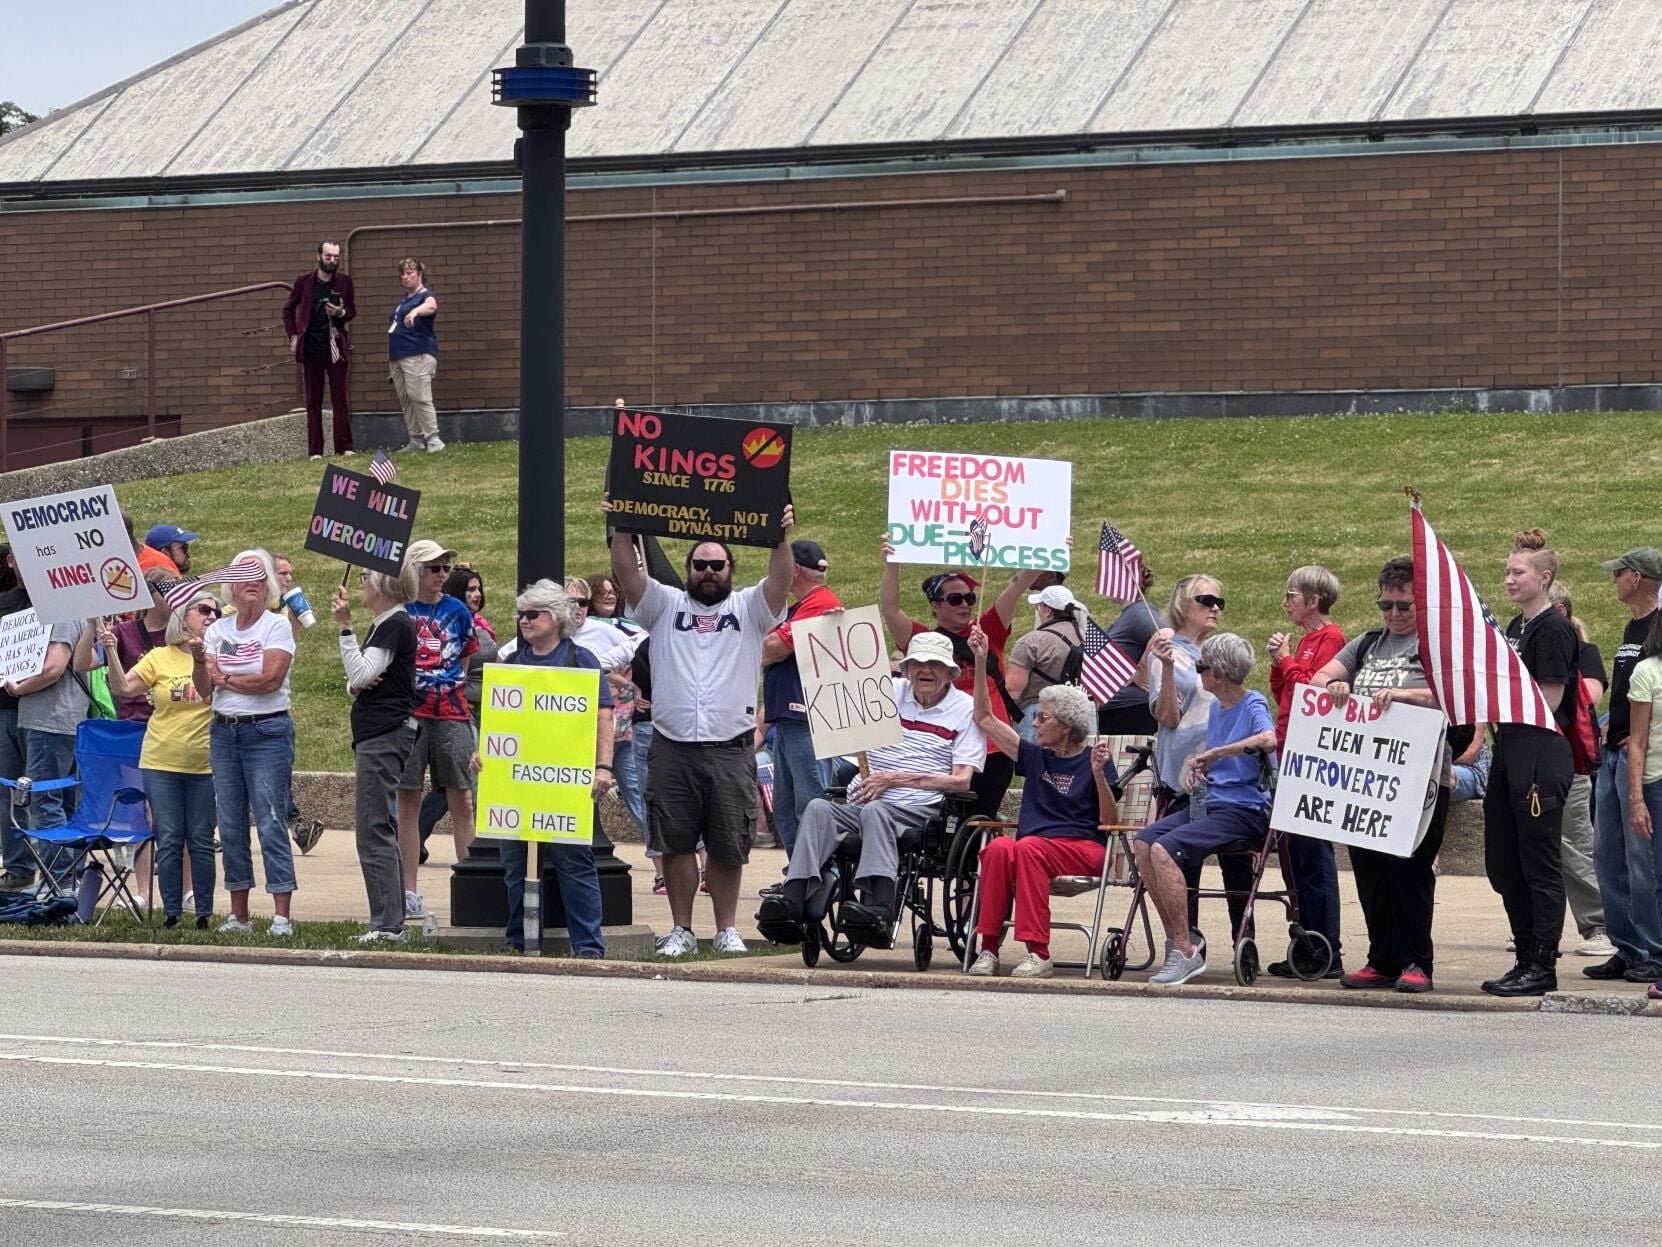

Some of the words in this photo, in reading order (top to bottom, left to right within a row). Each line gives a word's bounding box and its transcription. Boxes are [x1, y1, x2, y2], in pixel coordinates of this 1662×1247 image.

[618, 411, 662, 439] NO
[633, 444, 736, 479] KINGS
[892, 453, 1025, 484] FREEDOM
[332, 474, 359, 500] WE
[367, 490, 408, 520] WILL
[642, 472, 690, 488] SINCE
[703, 478, 736, 493] 1776
[941, 477, 1009, 504] DIES
[12, 494, 109, 531] DEMOCRACY
[612, 500, 711, 521] DEMOCRACY,
[734, 511, 769, 527] NOT
[911, 499, 1044, 530] WITHOUT
[36, 545, 57, 558] has
[74, 528, 104, 550] NO
[311, 515, 403, 563] OVERCOME
[668, 521, 748, 539] DYNASTY!
[46, 562, 96, 589] KING!
[2, 613, 37, 632] DEMOCR
[673, 612, 741, 633] USA
[808, 622, 879, 678] NO
[1354, 669, 1409, 687] EVERY
[491, 688, 523, 708] NO
[534, 694, 588, 713] KINGS
[804, 675, 899, 734] KINGS
[1301, 689, 1334, 717] SO
[1345, 697, 1382, 723] BAD
[487, 735, 518, 757] NO
[1318, 727, 1364, 754] EVEN
[1373, 737, 1410, 765] THE
[512, 764, 592, 785] FASCISTS
[1283, 750, 1400, 801] INTROVERTS
[489, 808, 520, 829] NO
[532, 813, 576, 832] HATE
[1294, 794, 1334, 824] ARE
[1341, 804, 1392, 837] HERE
